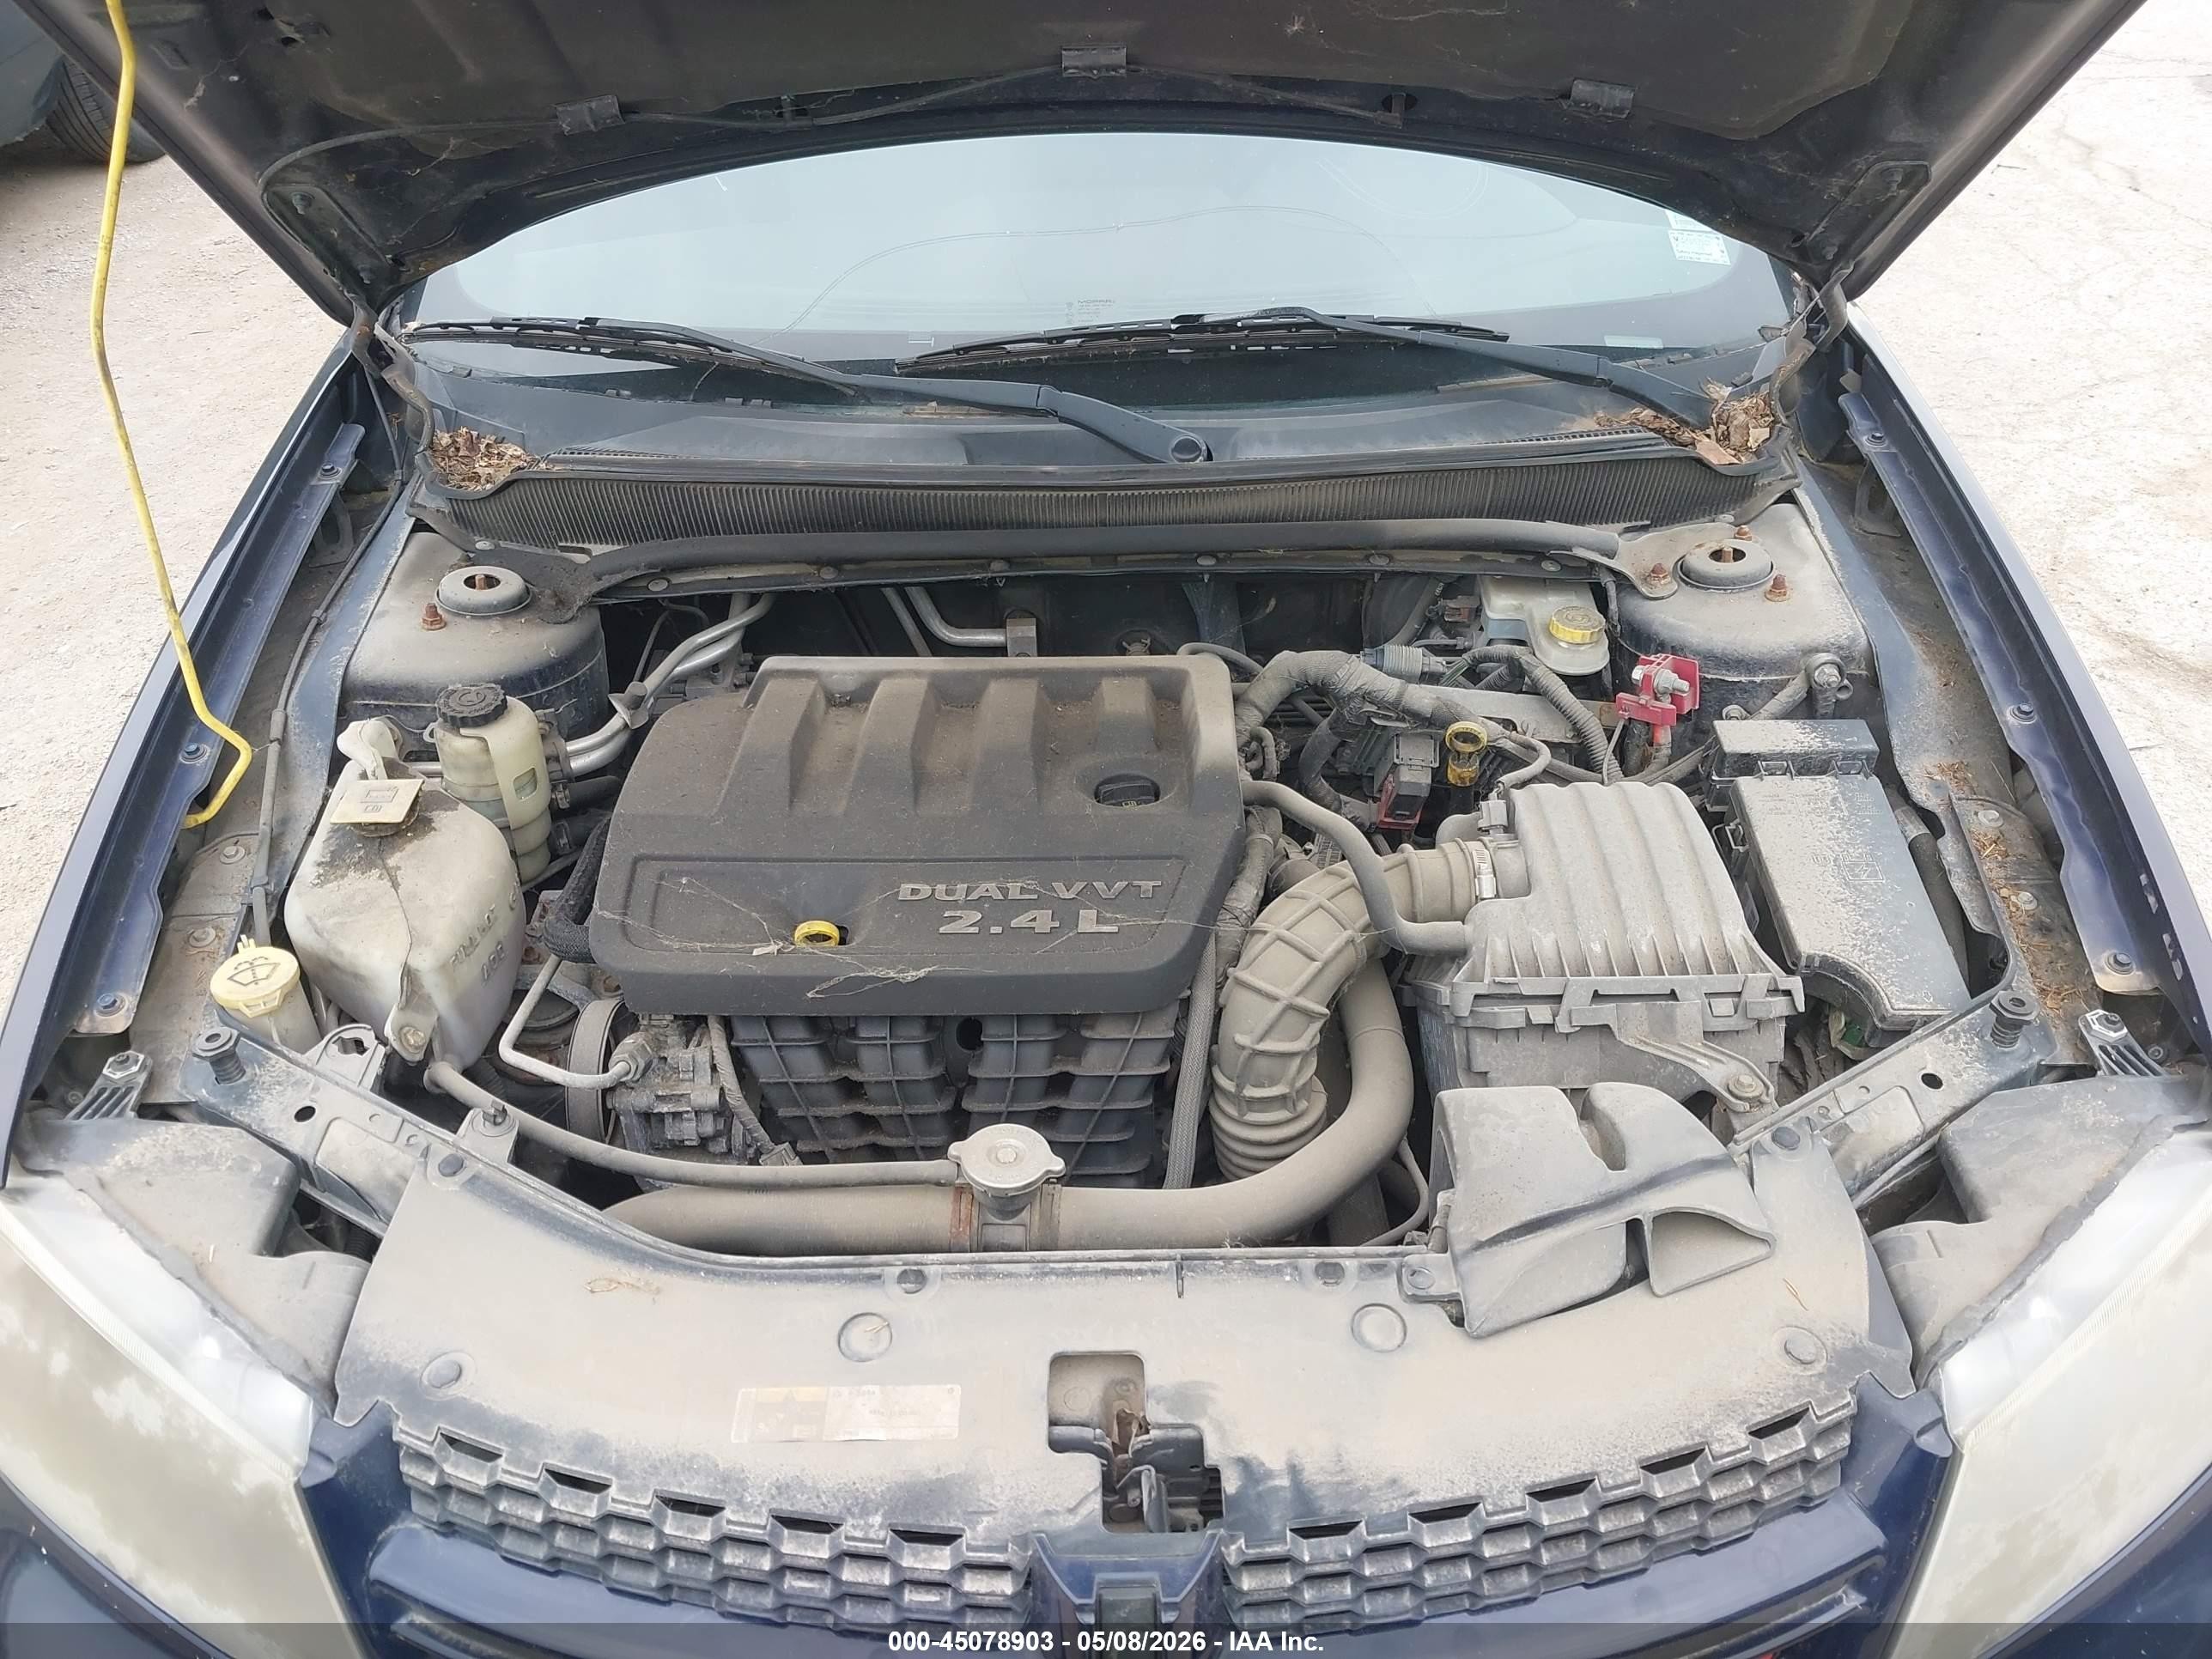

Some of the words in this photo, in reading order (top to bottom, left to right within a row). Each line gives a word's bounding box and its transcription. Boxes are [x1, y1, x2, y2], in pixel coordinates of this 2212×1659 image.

[898, 883, 1038, 901] DUAL
[1052, 881, 1162, 899] VVT
[939, 909, 1060, 934] 2.4
[1077, 909, 1119, 933] L
